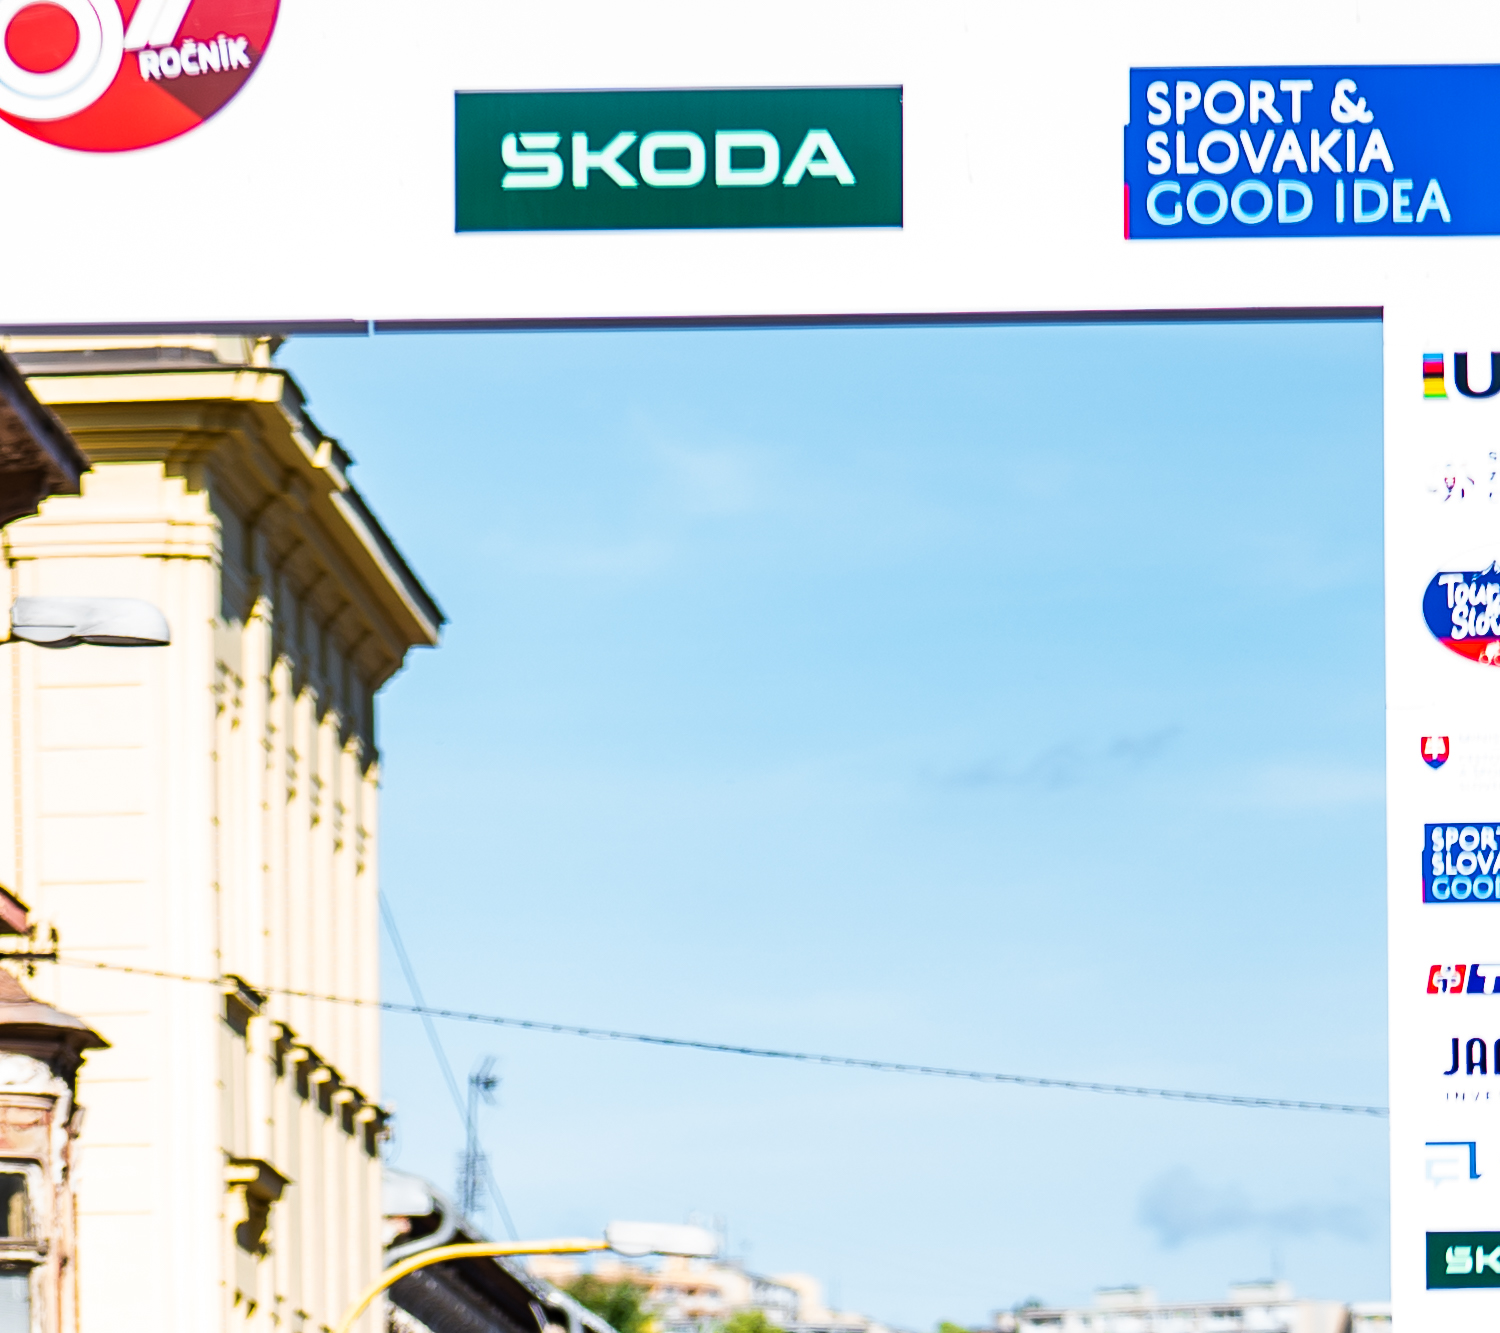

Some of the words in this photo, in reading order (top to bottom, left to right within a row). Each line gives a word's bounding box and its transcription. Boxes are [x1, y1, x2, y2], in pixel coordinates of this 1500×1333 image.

[138, 34, 251, 81] ROČNÍK
[1144, 79, 1316, 128] SPORT
[1329, 79, 1375, 126] &
[1144, 129, 1395, 177] SLOVAKIA
[1144, 177, 1316, 226] GOOD
[1333, 177, 1453, 225] IDEA
